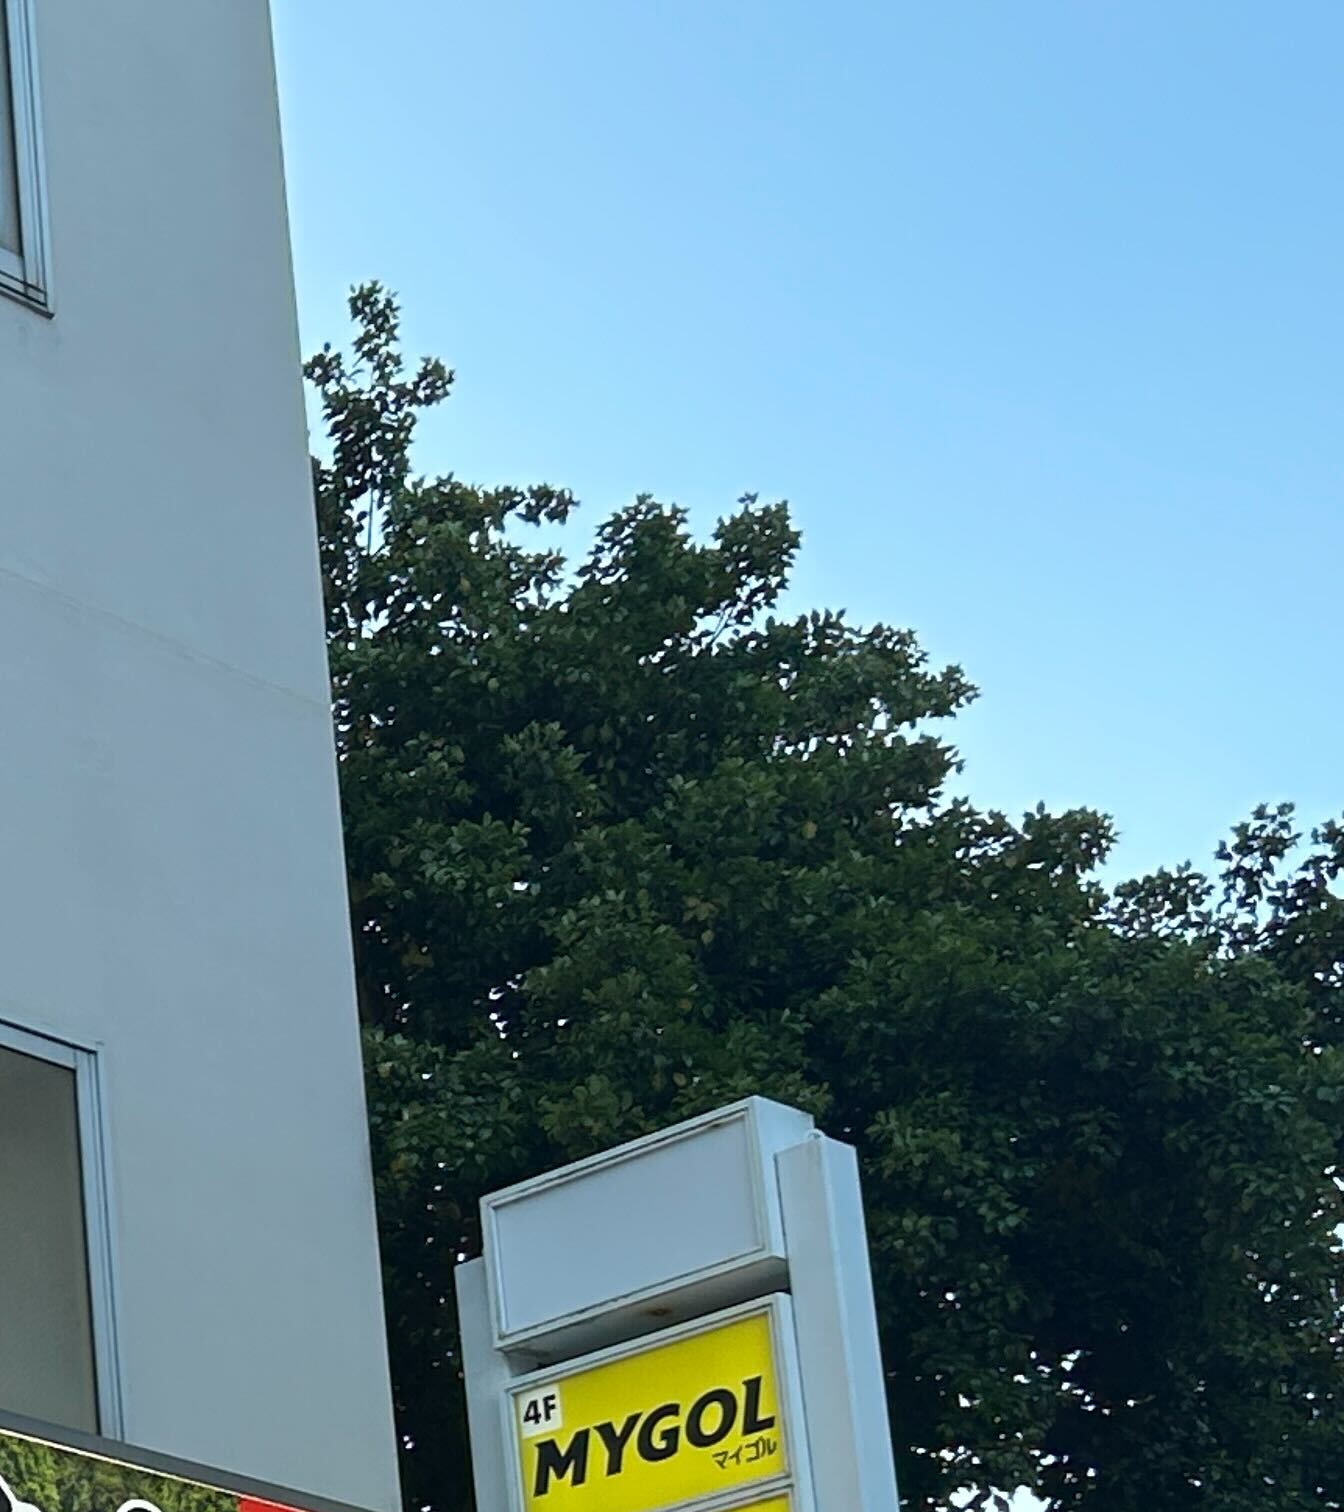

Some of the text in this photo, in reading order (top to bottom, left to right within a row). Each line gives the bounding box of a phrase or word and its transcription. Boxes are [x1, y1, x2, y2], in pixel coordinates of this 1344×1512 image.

[523, 1393, 558, 1426] 4F
[533, 1375, 776, 1497] MYGOL
[713, 1436, 778, 1470] マイゴル
